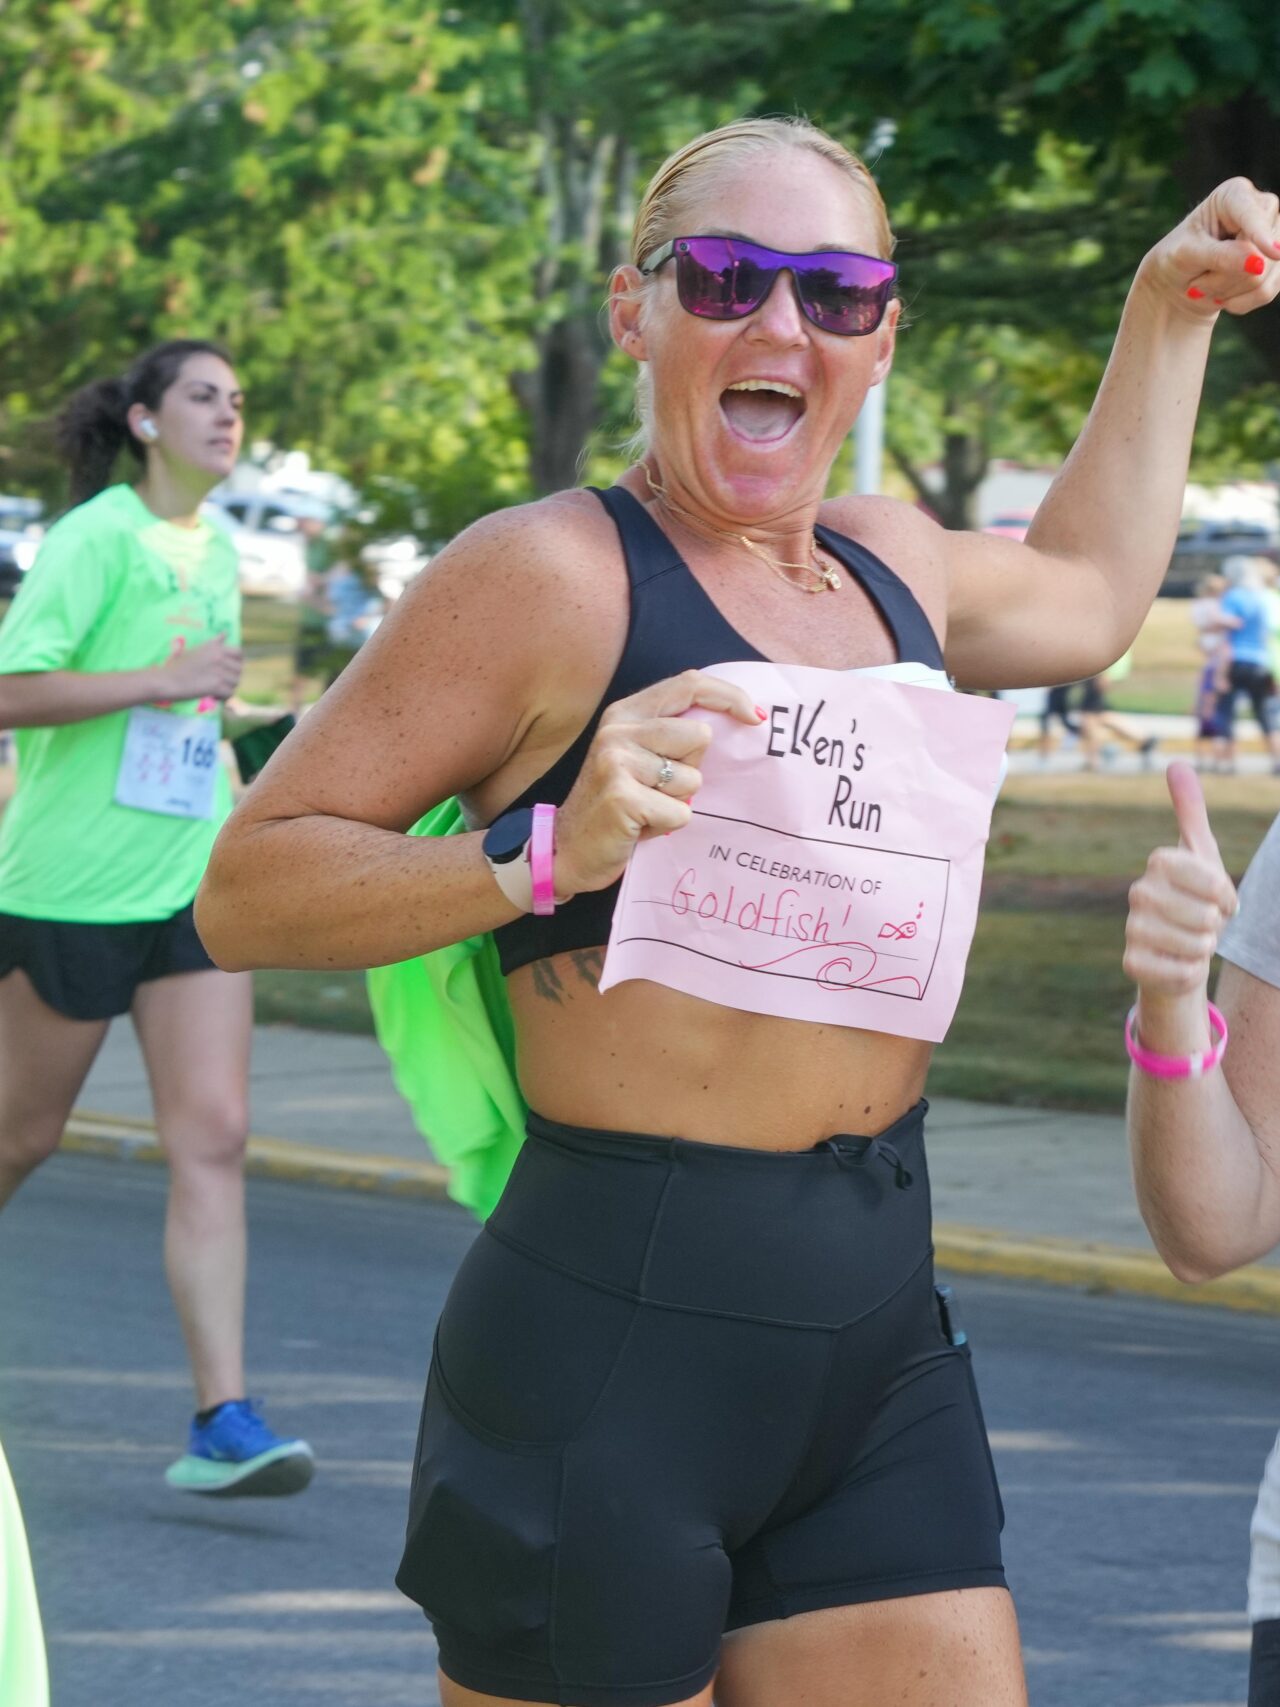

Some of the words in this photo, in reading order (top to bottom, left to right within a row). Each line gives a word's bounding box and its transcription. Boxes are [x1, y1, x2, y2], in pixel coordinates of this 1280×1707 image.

[767, 699, 865, 771] Ellen's
[828, 774, 881, 833] Run
[708, 844, 732, 861] IN
[735, 852, 856, 892] CELEBRATION
[860, 879, 882, 896] OF
